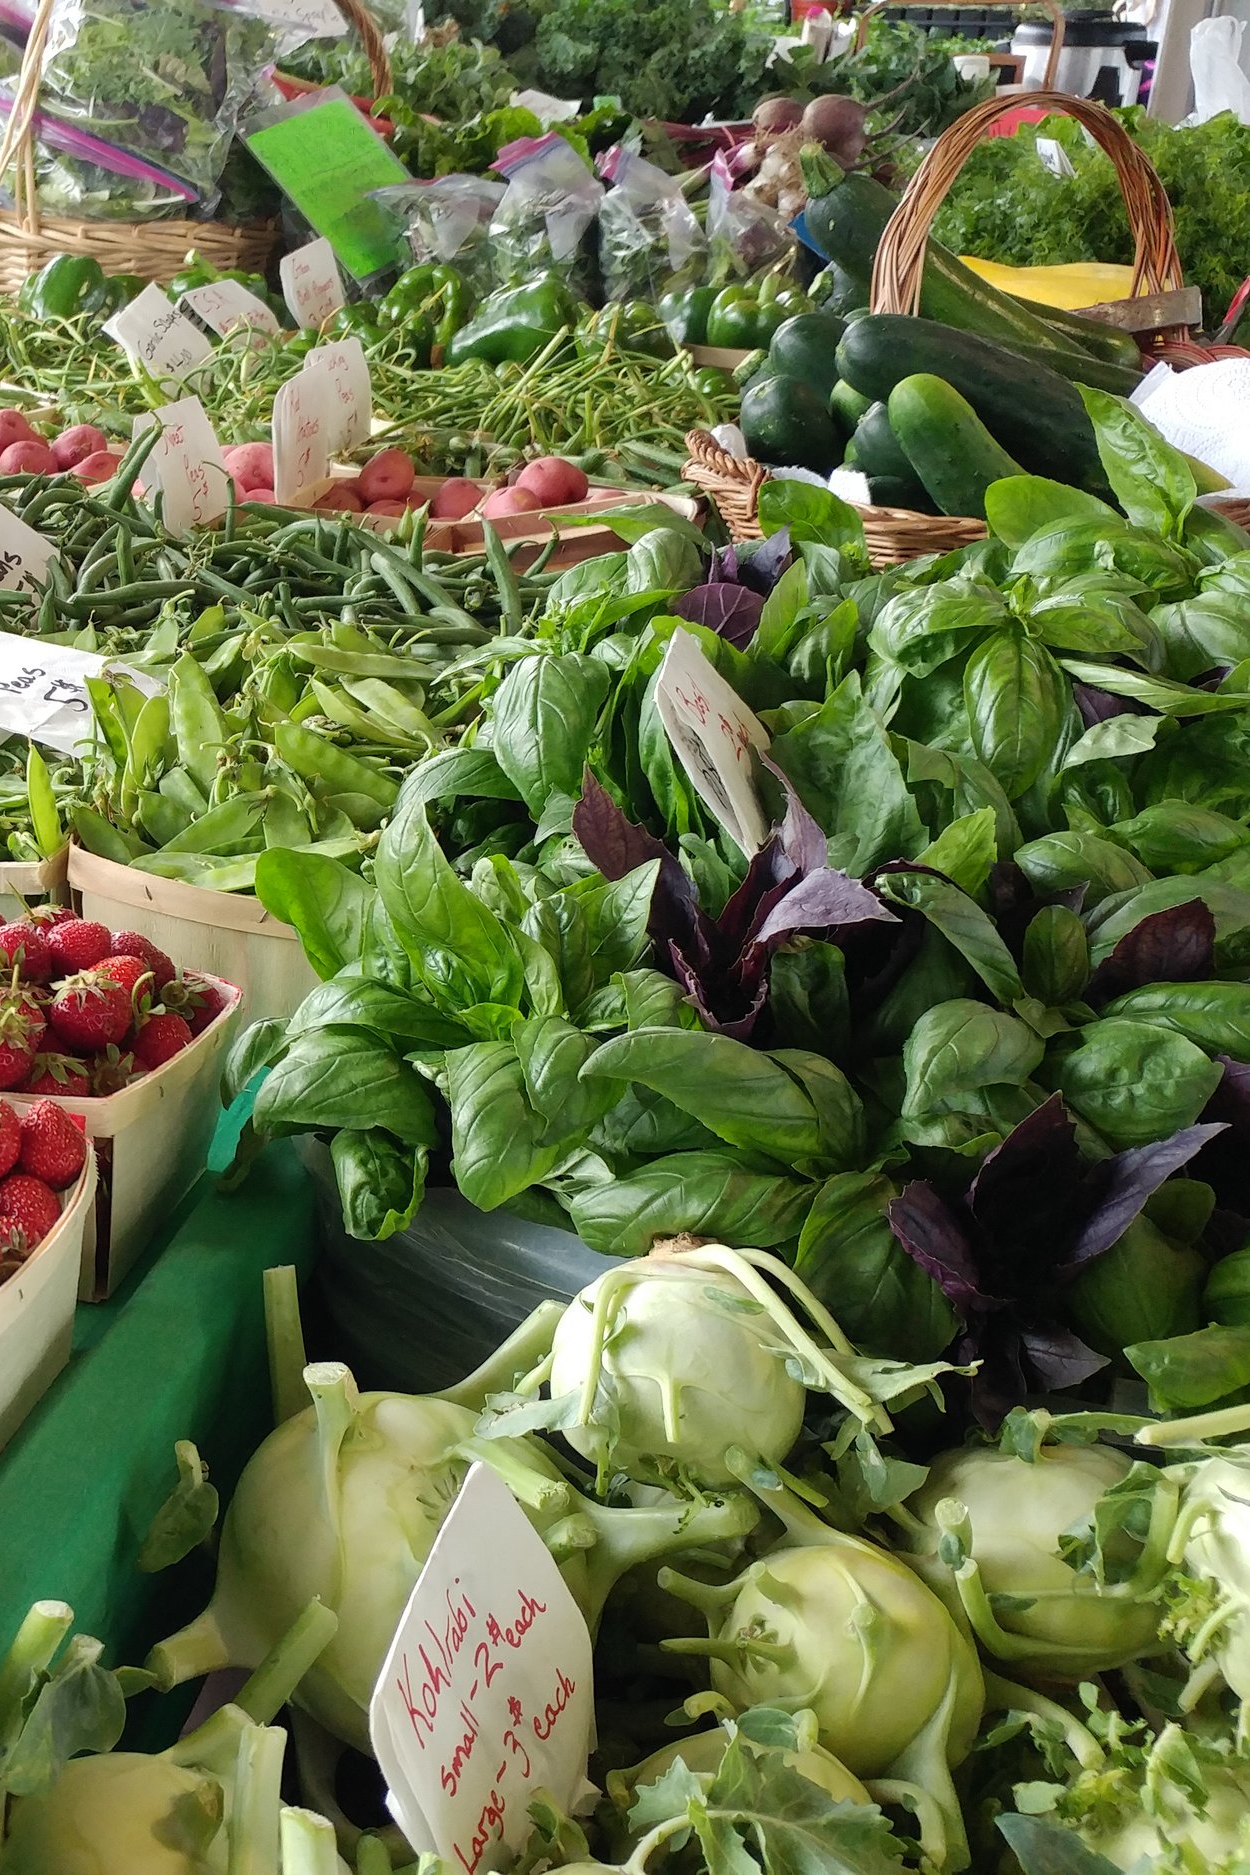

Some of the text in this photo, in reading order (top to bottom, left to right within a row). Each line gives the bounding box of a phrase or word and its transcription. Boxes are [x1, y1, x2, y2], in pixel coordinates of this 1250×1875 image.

[504, 1588, 547, 1649] each
[396, 1577, 477, 1750] Kohlrabi
[533, 1667, 576, 1743] each
